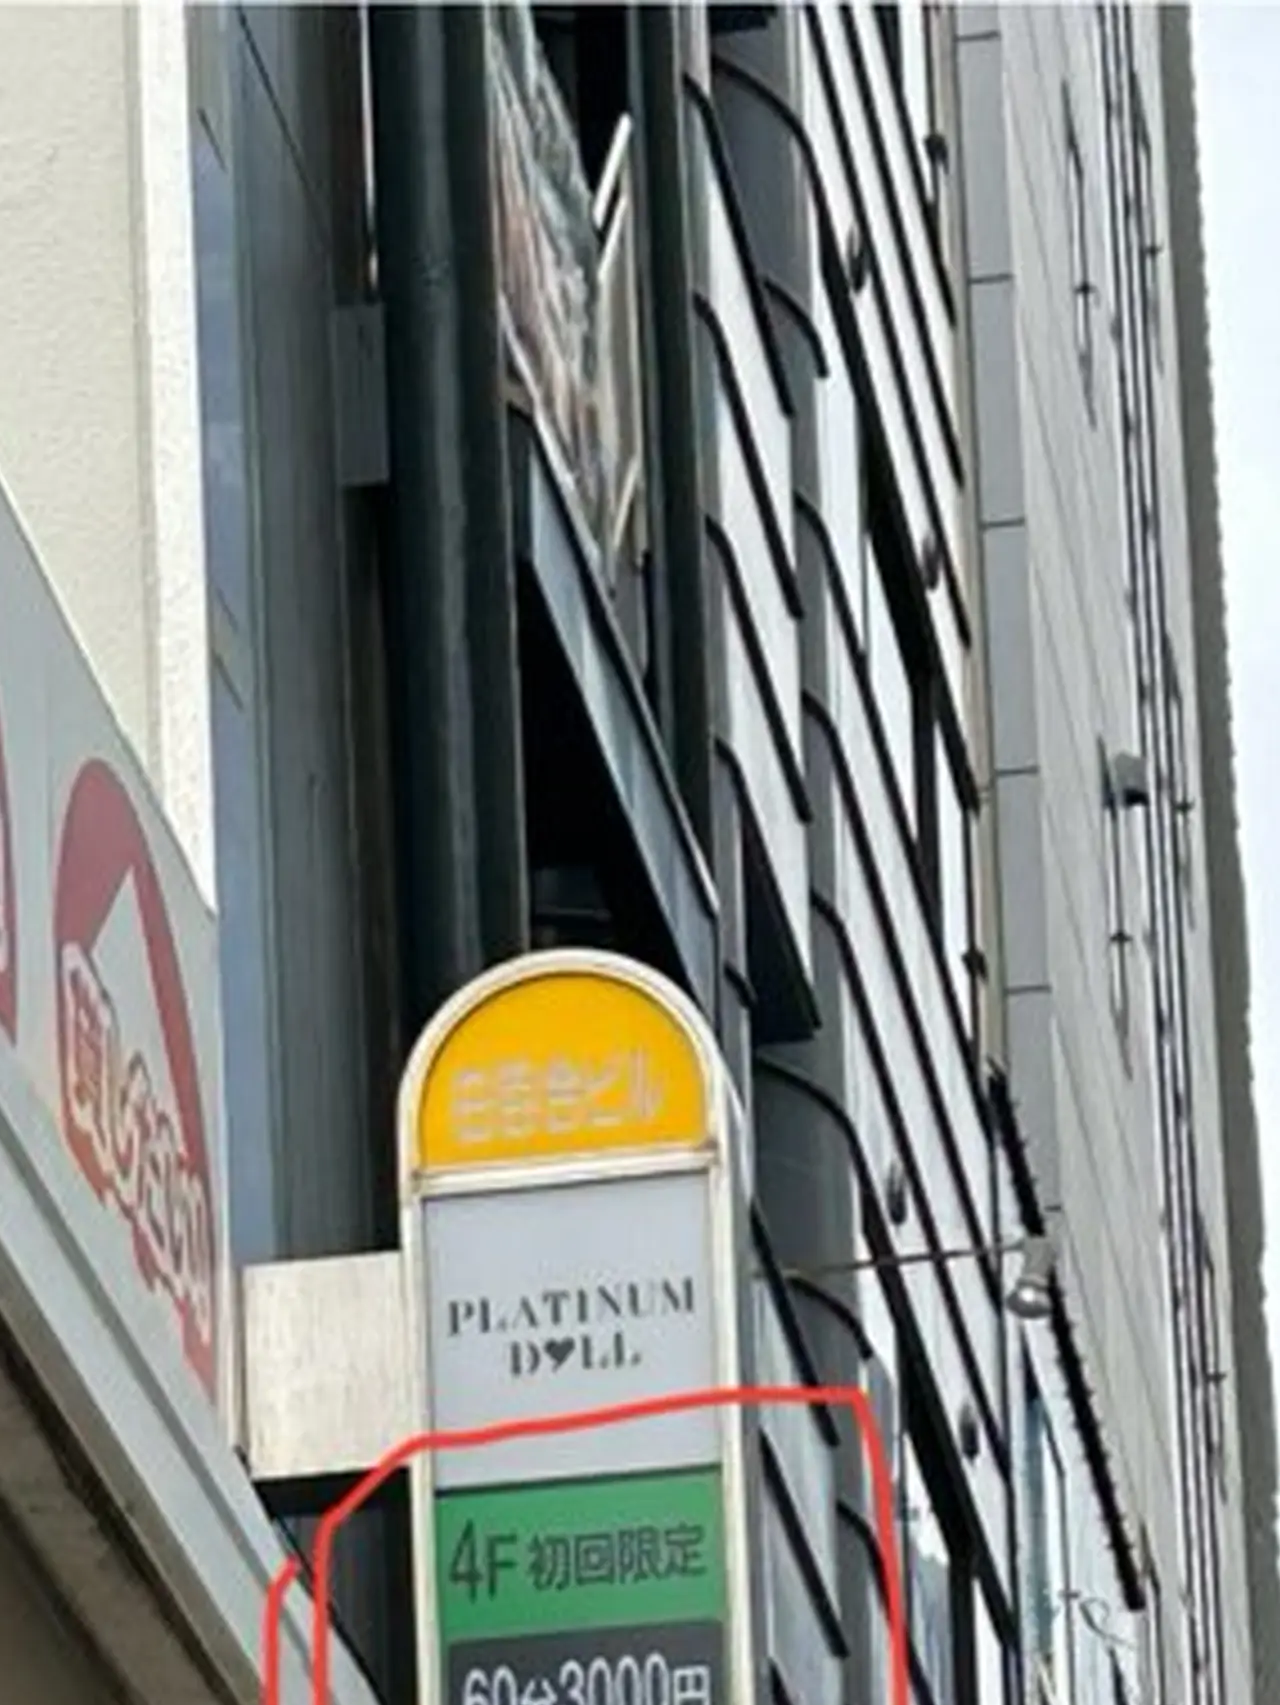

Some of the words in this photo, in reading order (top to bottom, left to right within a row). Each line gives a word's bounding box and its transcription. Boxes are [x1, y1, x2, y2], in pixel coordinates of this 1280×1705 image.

[447, 1277, 697, 1338] PLATINUM
[526, 1522, 708, 1592] 初回限定
